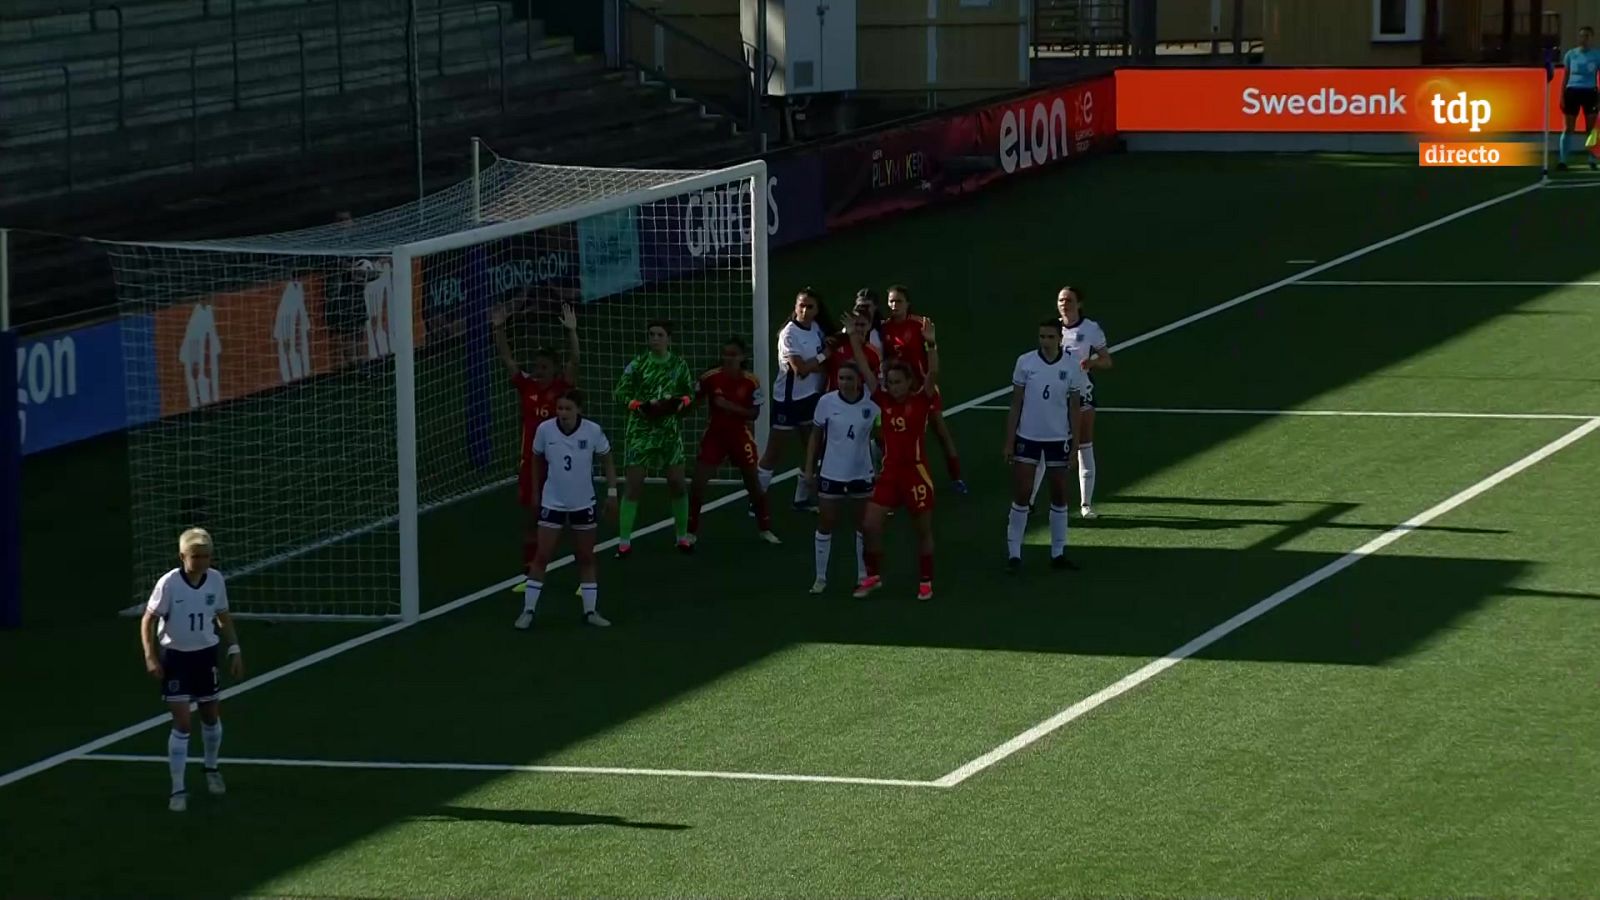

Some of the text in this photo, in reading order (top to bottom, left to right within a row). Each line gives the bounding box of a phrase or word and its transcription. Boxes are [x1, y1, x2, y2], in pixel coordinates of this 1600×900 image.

[1242, 87, 1407, 115] Swedbank
[1042, 386, 1050, 400] 6
[534, 406, 550, 419] 16
[846, 425, 855, 440] 4
[890, 416, 907, 433] 19
[744, 442, 754, 458] 9
[563, 456, 572, 471] 3
[911, 484, 927, 503] 19
[188, 612, 204, 631] 11
